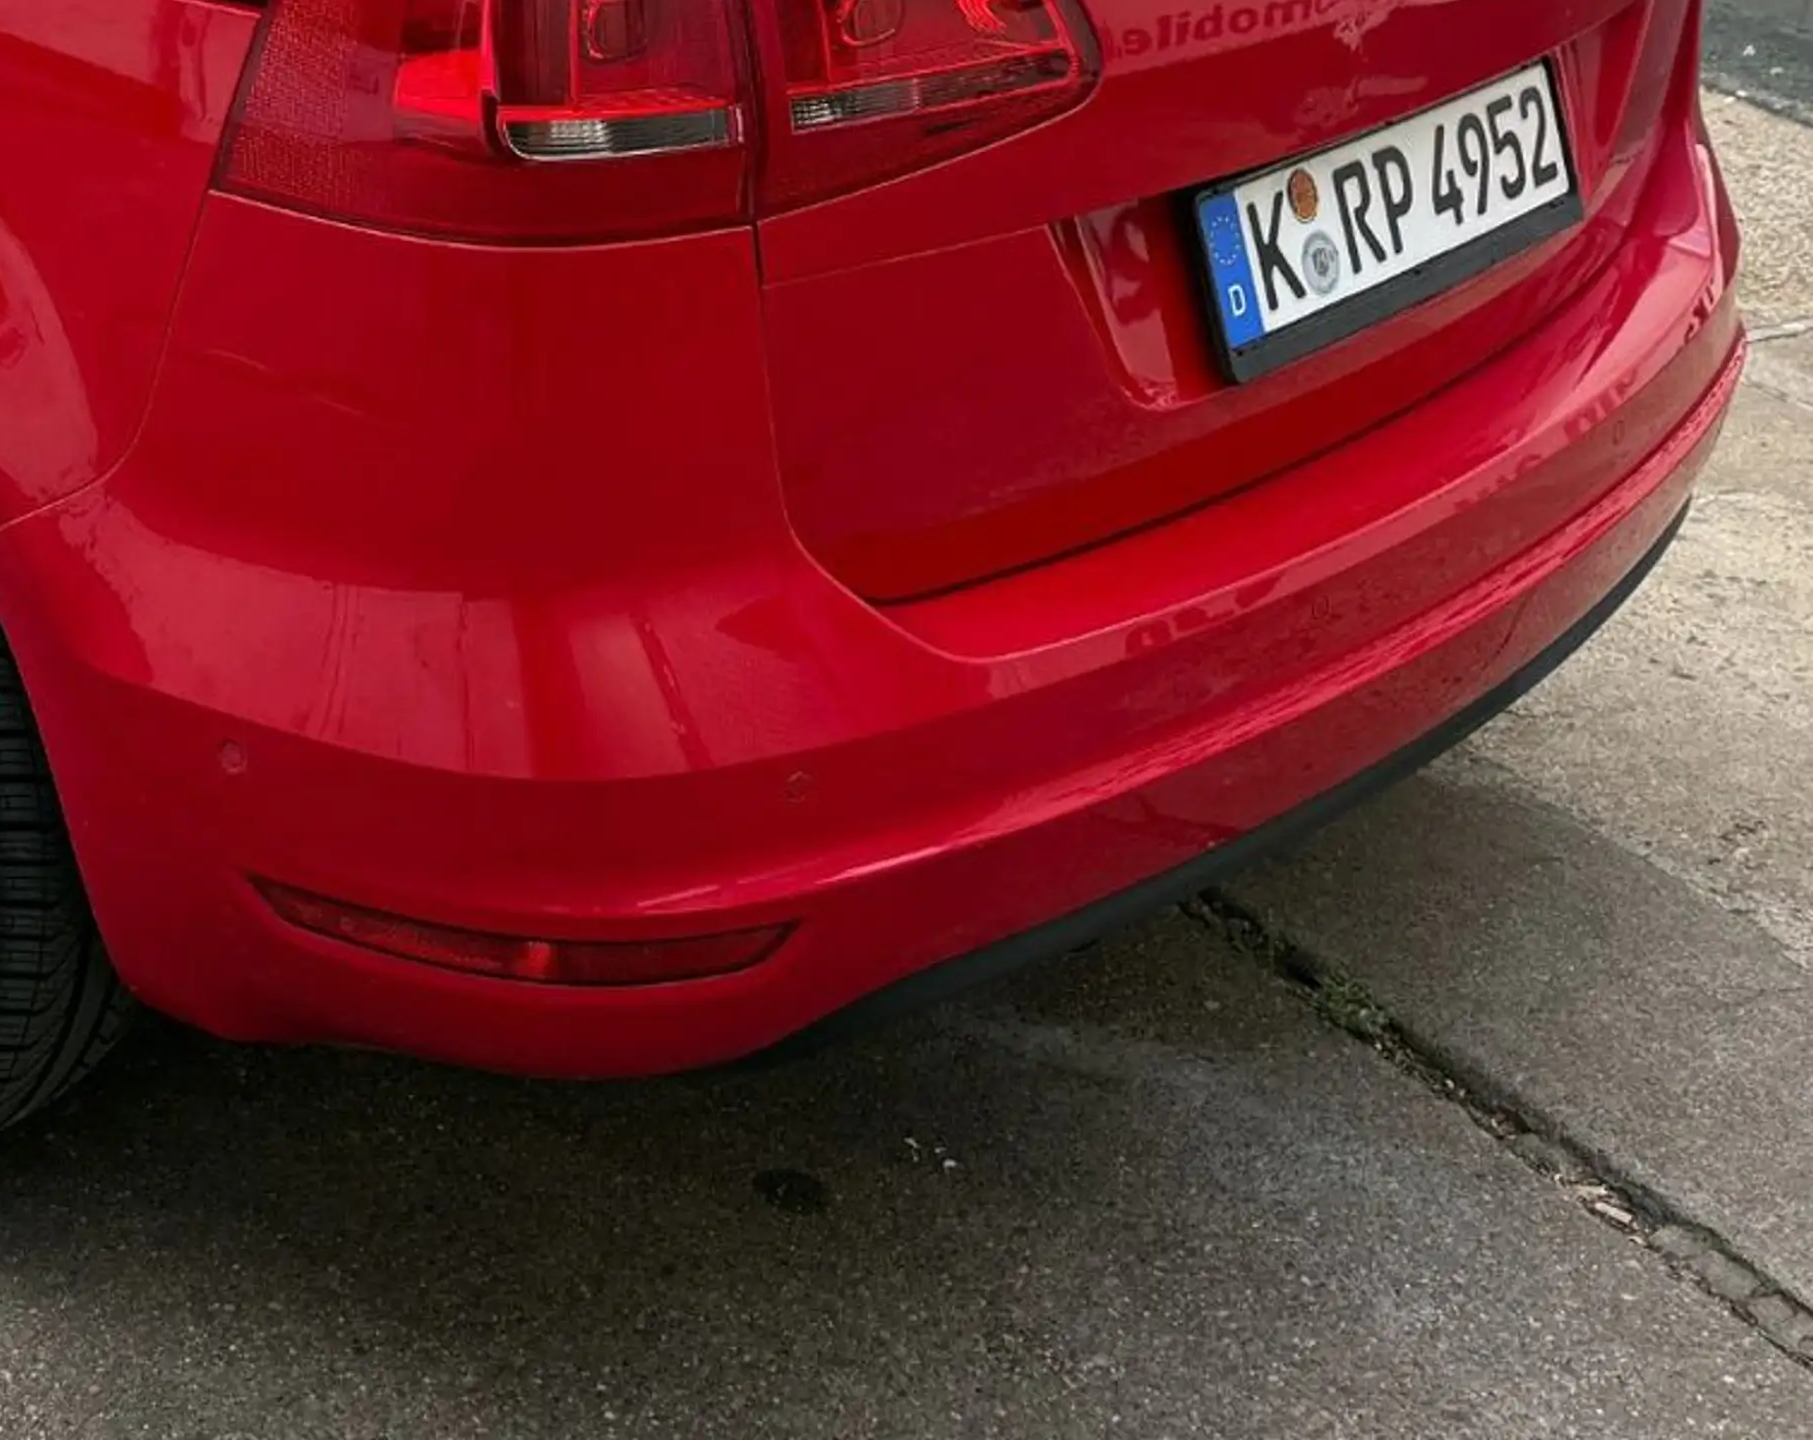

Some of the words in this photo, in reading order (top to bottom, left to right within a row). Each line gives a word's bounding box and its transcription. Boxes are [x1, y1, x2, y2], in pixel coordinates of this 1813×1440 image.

[1228, 284, 1246, 318] D
[1246, 190, 1306, 311] K
[1332, 145, 1414, 275] RP
[1431, 85, 1558, 227] 4952
